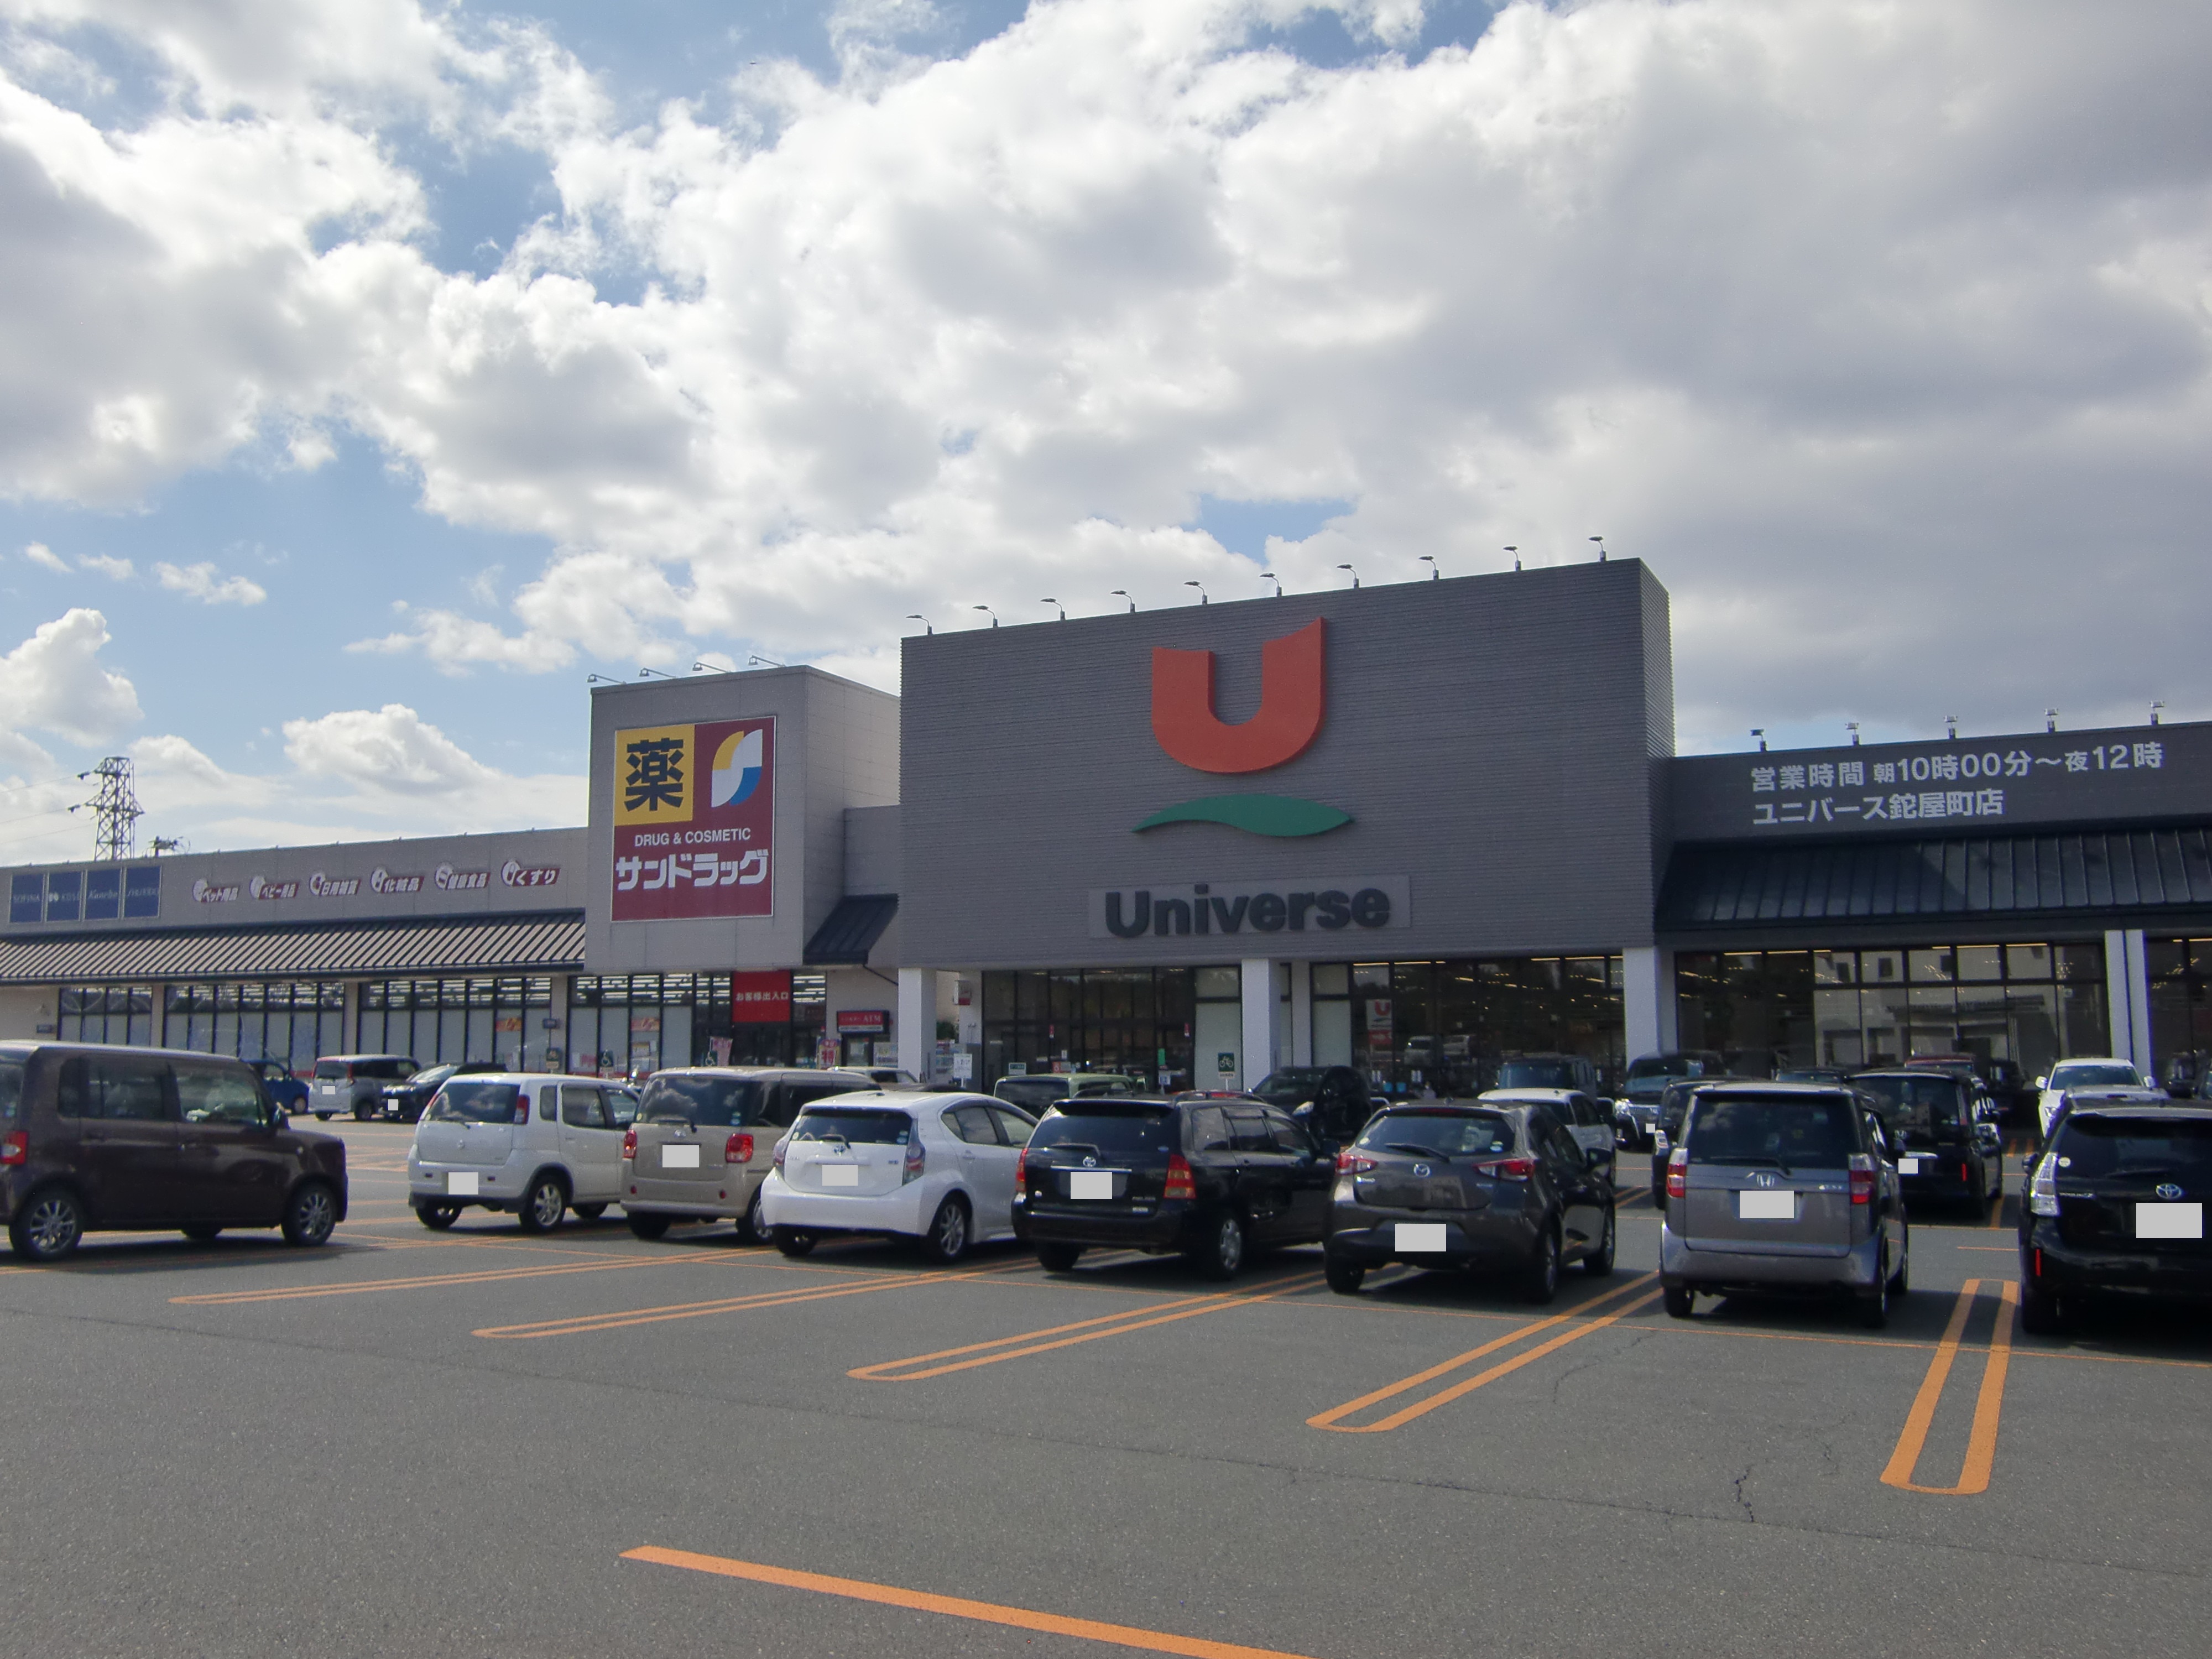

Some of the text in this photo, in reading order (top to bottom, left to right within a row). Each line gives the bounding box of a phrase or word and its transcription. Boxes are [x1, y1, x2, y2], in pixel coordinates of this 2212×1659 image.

[1151, 616, 1328, 775] U
[623, 737, 685, 812] 薬
[1751, 761, 1865, 792] 営業時間
[1752, 788, 2004, 825] ユニバース鉈屋町店
[634, 827, 752, 847] DRUG & COSMETIC
[516, 869, 556, 885] くすり
[615, 848, 769, 891] サンドラッグ
[1105, 884, 1391, 938] Universe
[735, 992, 789, 1002] お客様出入口
[863, 1014, 881, 1022] ATM
